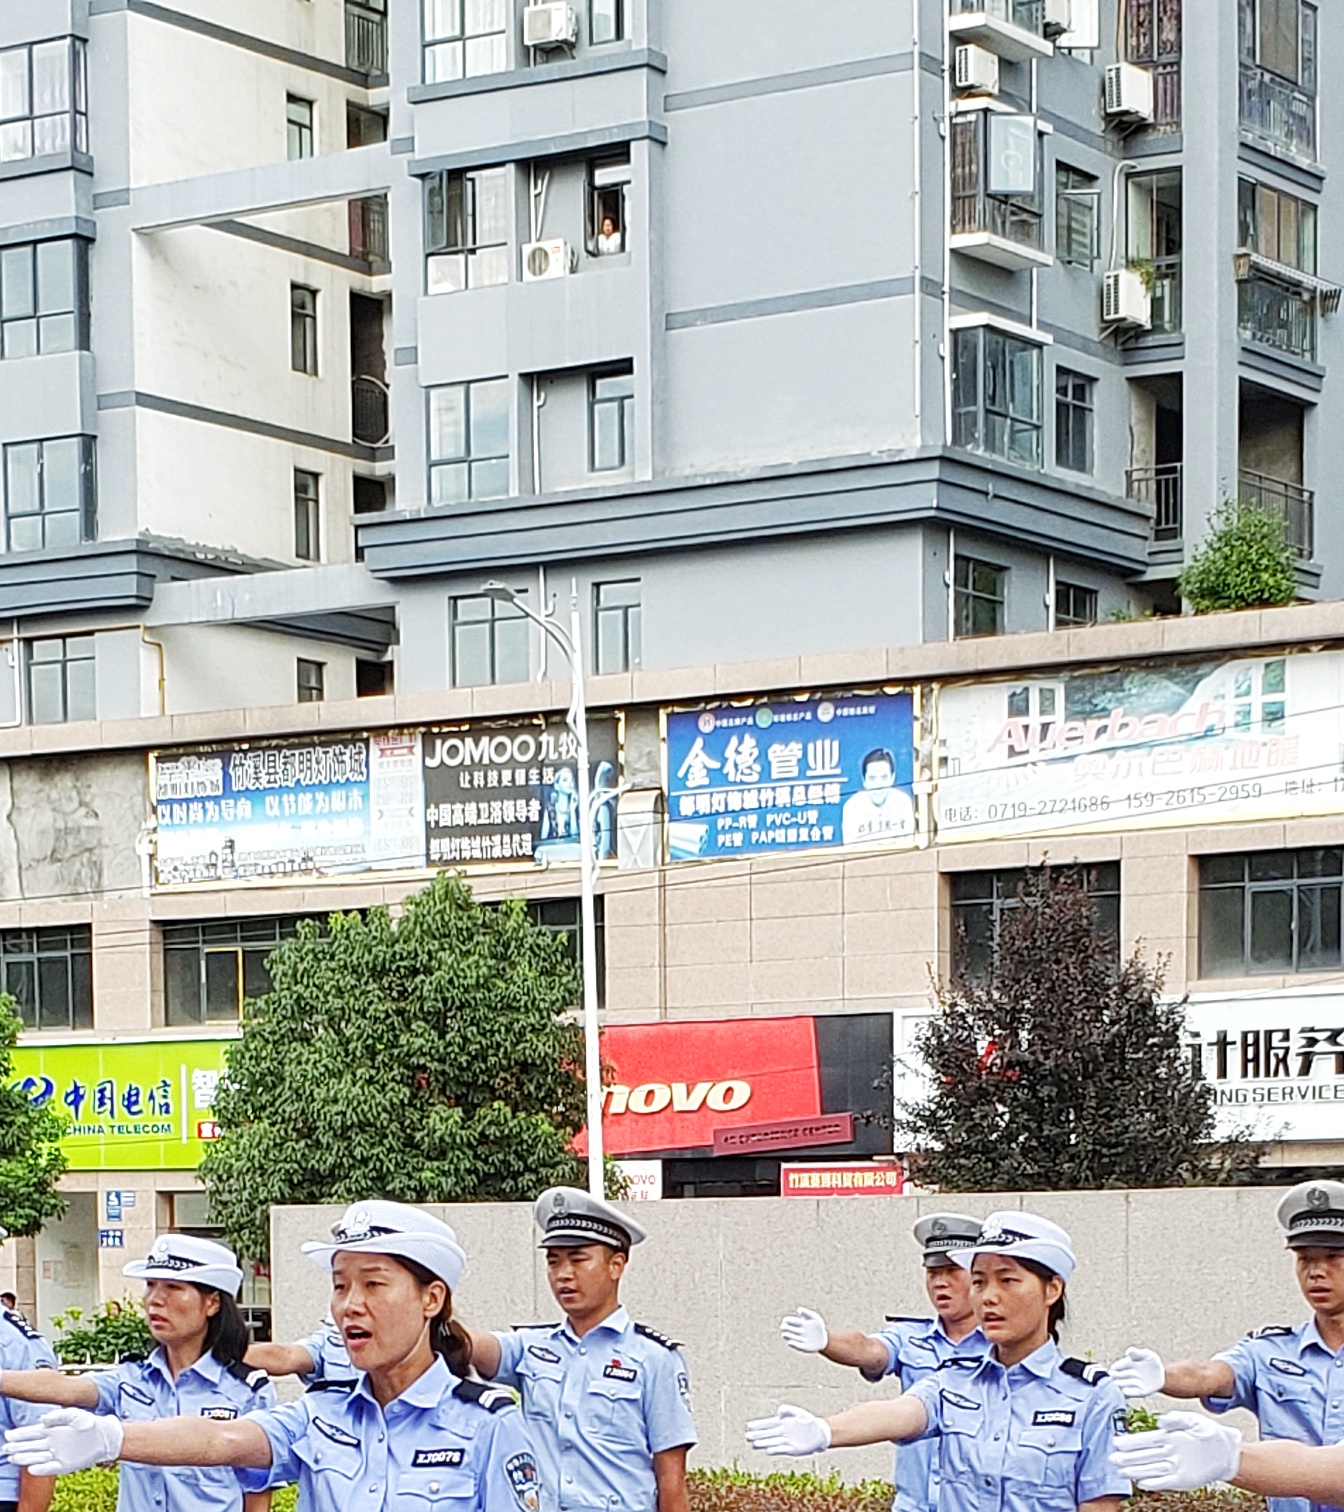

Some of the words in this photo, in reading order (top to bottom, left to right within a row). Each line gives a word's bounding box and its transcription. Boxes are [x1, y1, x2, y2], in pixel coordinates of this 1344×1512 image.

[988, 701, 1227, 755] Auerbach
[229, 743, 368, 792] 竹溪县都明灯饰城
[424, 733, 536, 769] JOMOO
[537, 732, 586, 762] 九牧
[677, 732, 842, 789] 金德管业
[426, 797, 542, 829] 中国高端卫浴领导者
[63, 1078, 173, 1122] 中国电信
[601, 1079, 752, 1115] novo
[65, 1123, 105, 1136] CHINA
[110, 1122, 173, 1135] TELECOM
